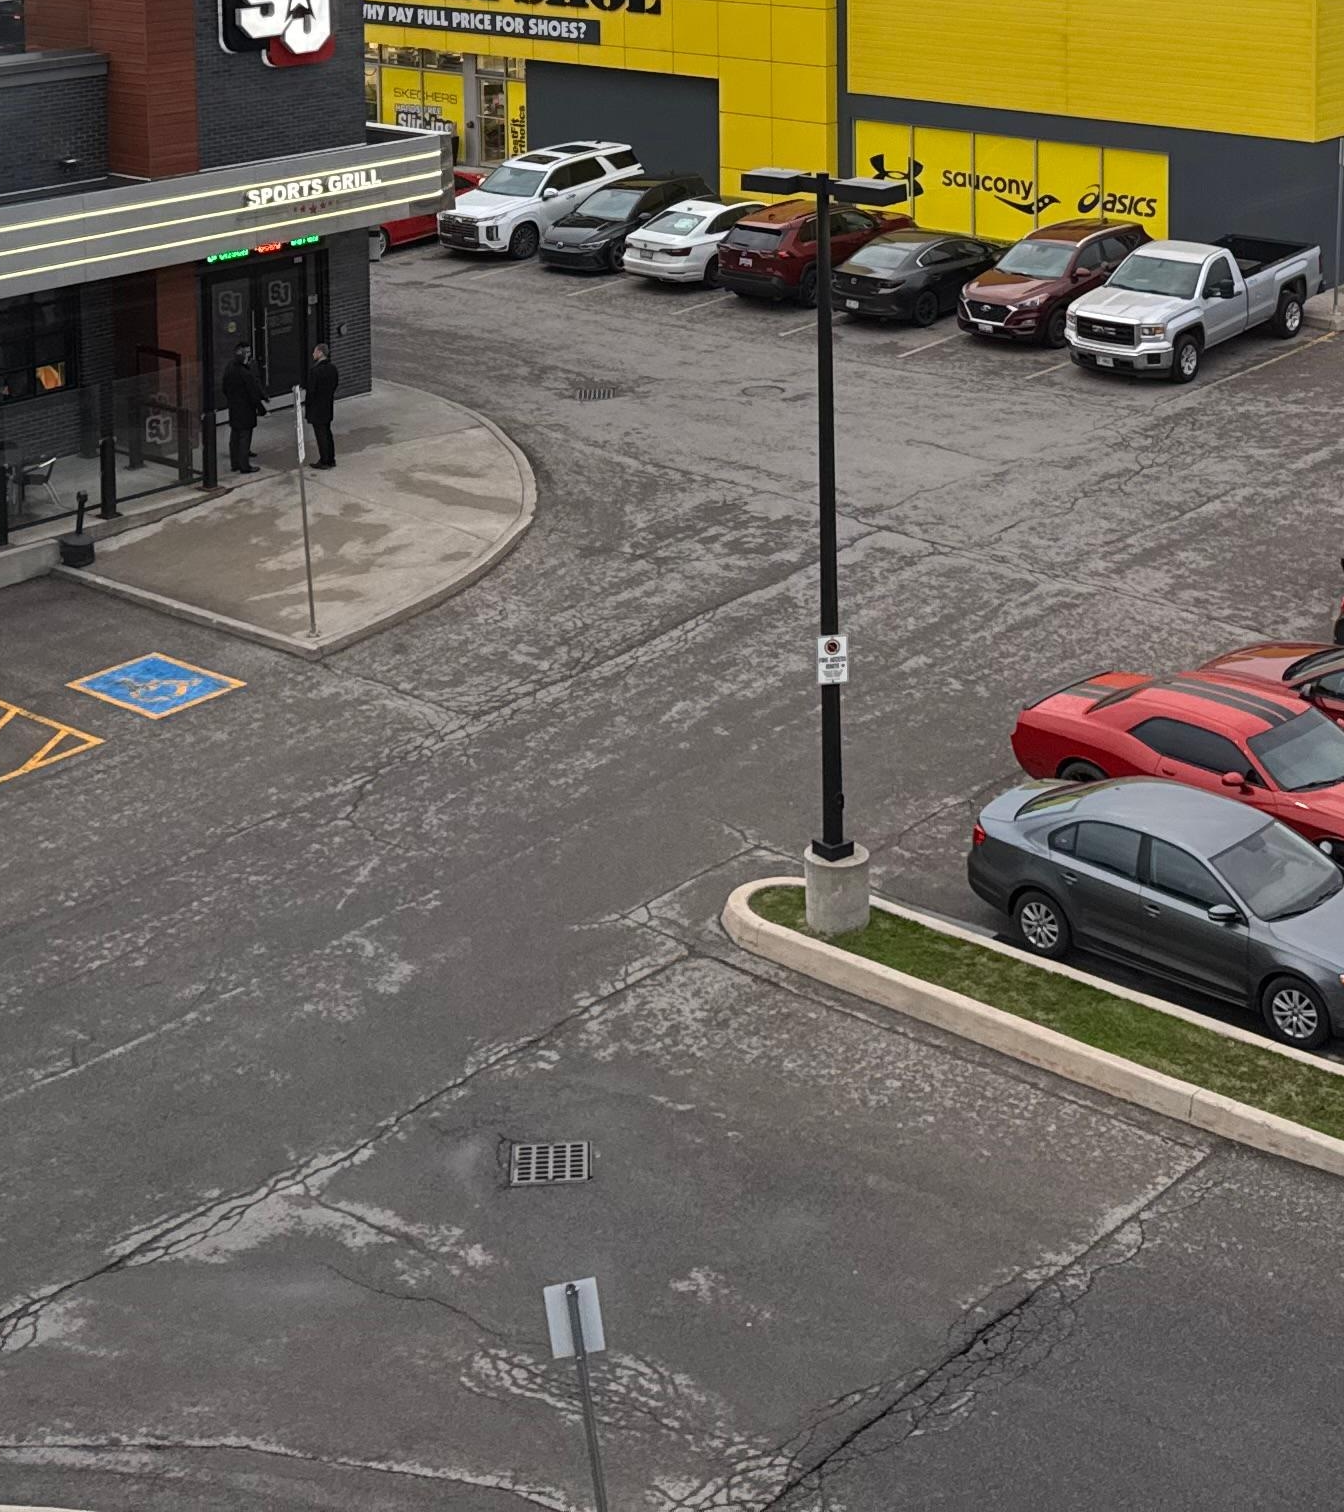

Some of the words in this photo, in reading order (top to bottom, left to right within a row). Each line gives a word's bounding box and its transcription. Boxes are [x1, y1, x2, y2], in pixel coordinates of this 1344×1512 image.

[388, 6, 414, 23] PAY
[417, 8, 449, 27] FULL
[452, 12, 492, 31] PRICE
[495, 16, 525, 34] FOR
[528, 20, 587, 39] SHOES?
[245, 178, 324, 208] SPORTS
[328, 168, 382, 193] GRILL
[942, 169, 1035, 201] saucony
